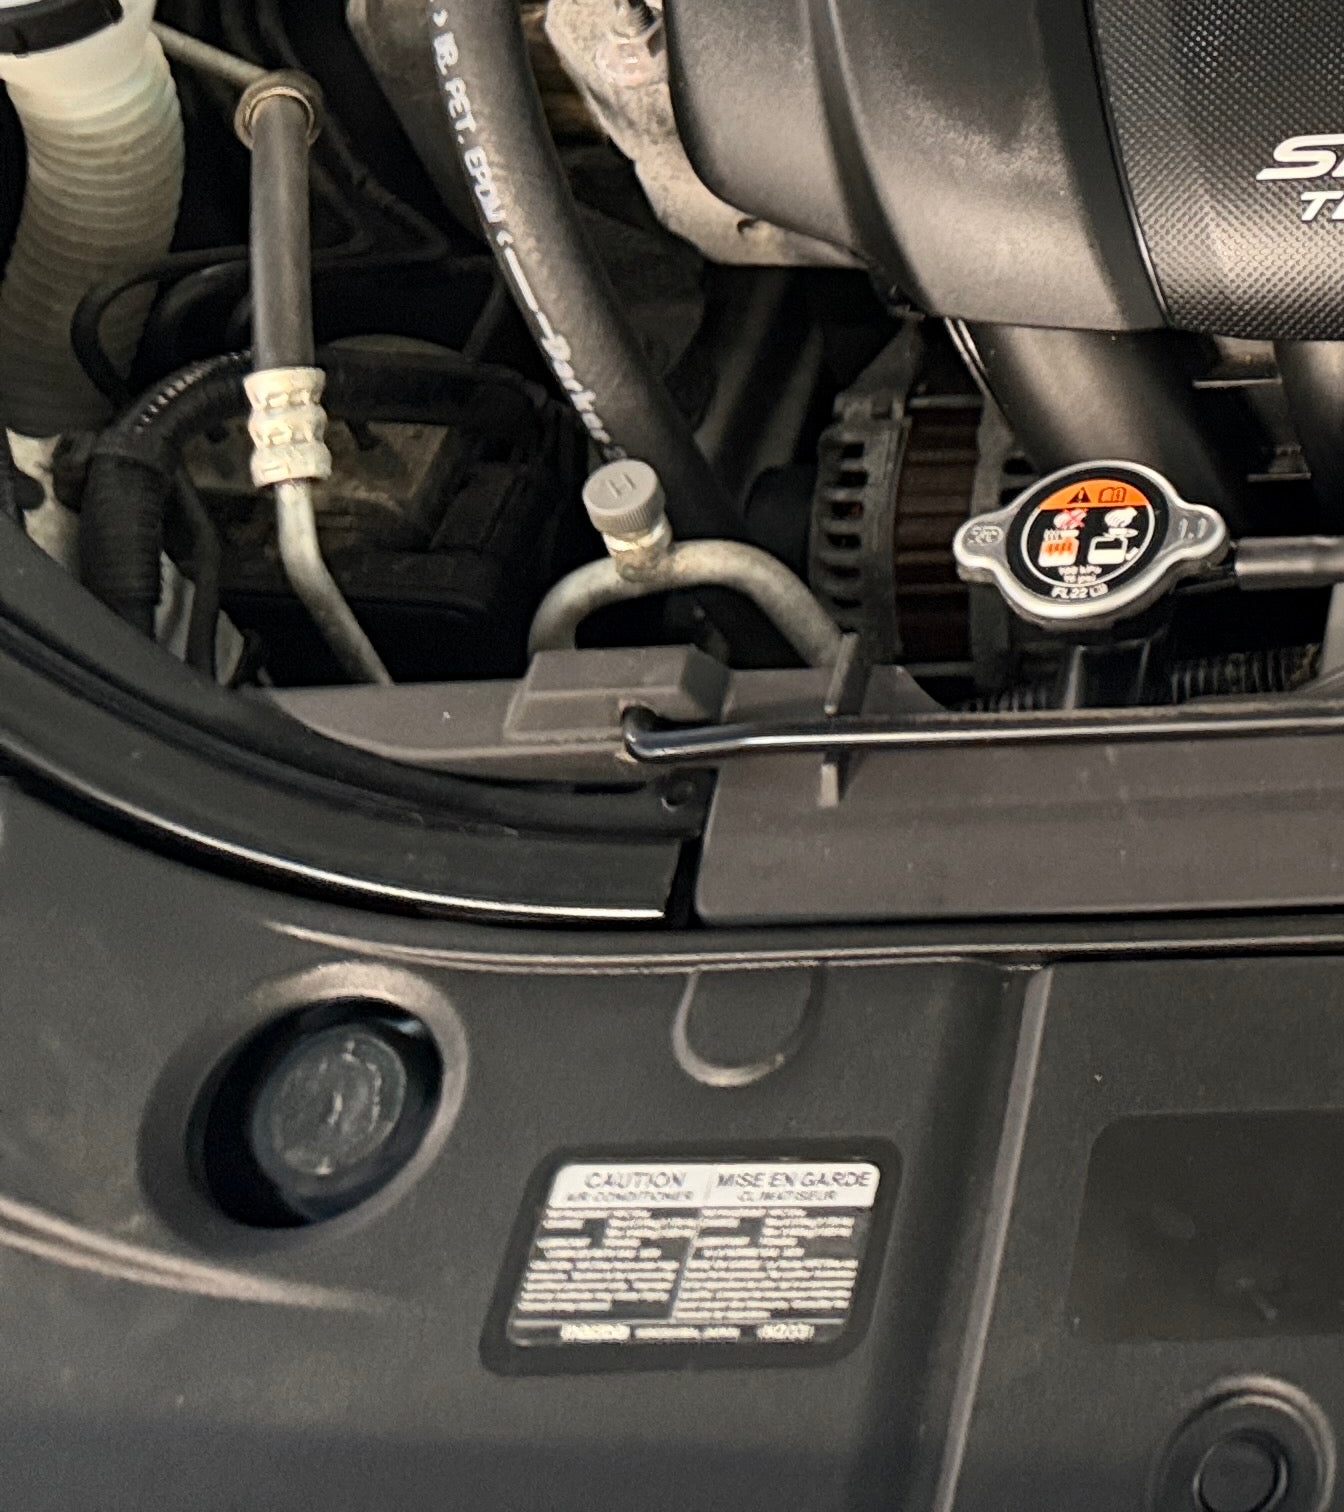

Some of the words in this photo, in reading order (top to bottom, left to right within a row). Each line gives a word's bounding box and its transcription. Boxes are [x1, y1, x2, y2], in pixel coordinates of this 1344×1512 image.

[583, 1171, 688, 1189] CAUTION
[717, 1172, 766, 1188] MISE
[767, 1171, 797, 1188] EN
[800, 1171, 873, 1188] GARDE
